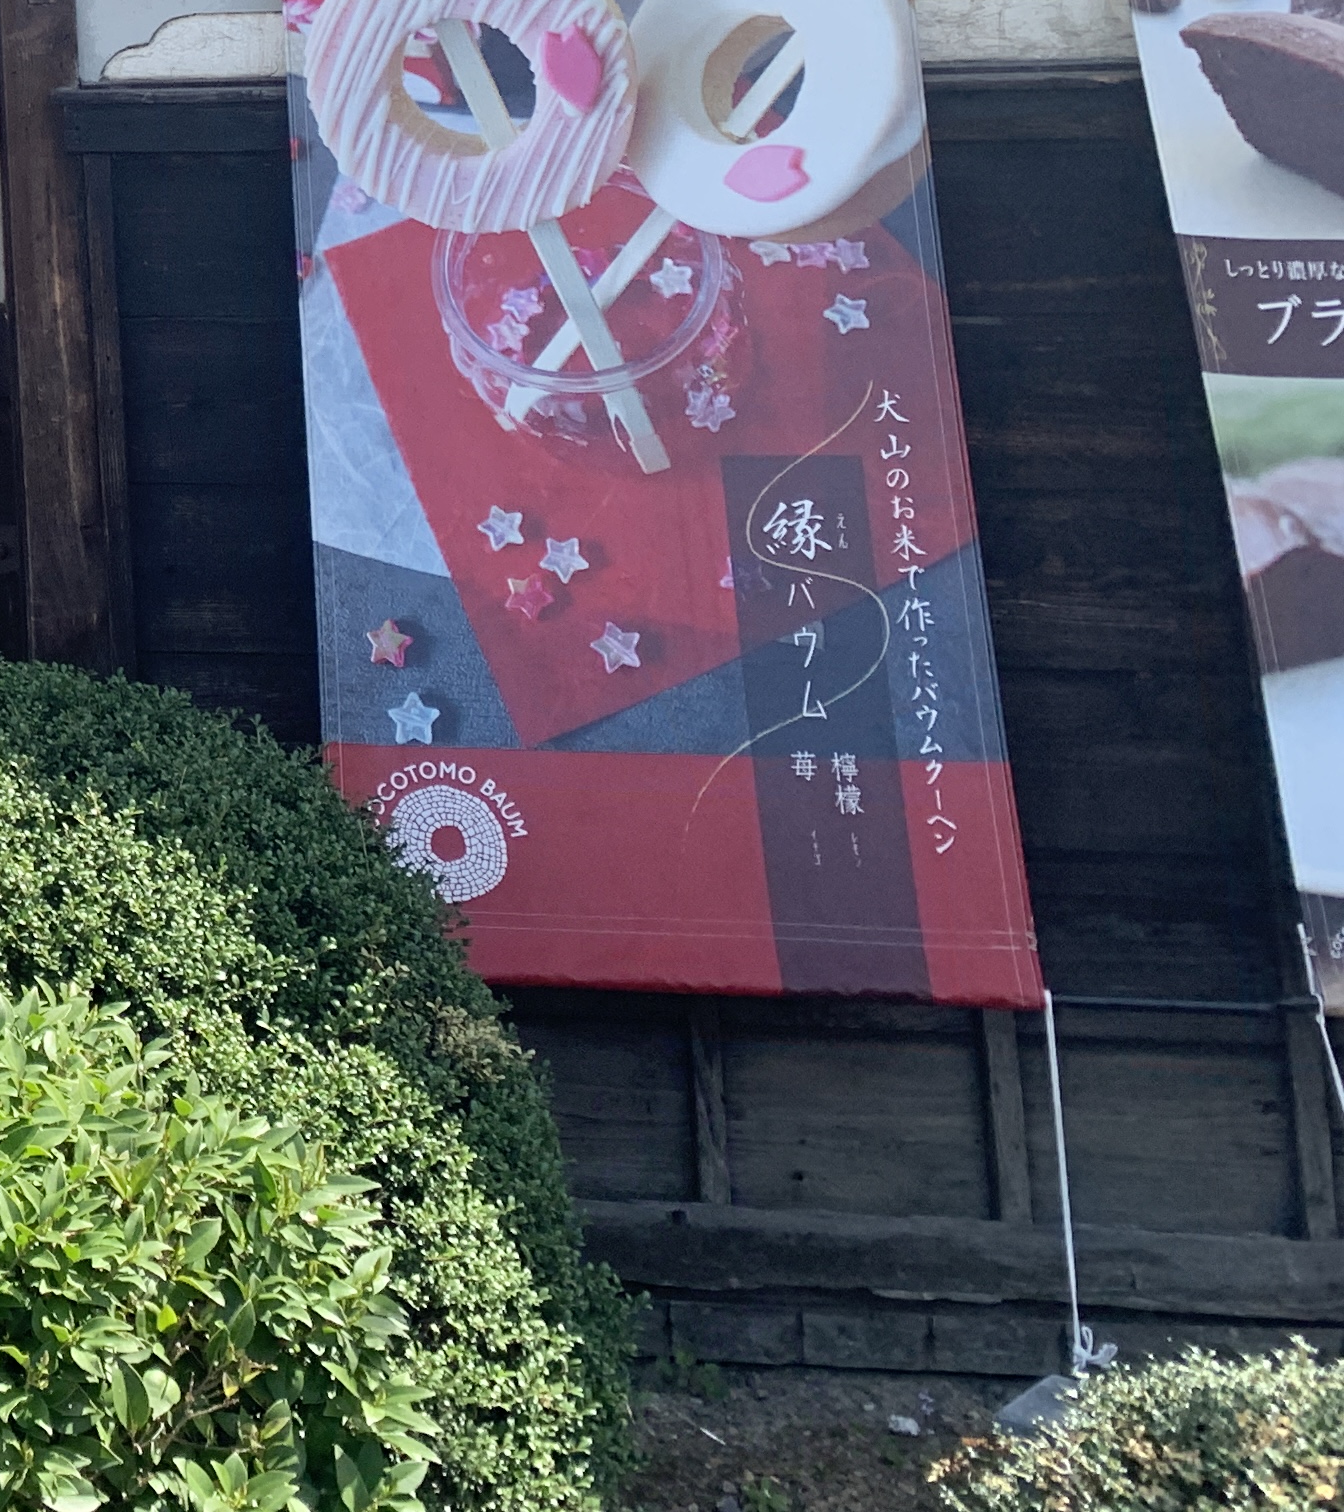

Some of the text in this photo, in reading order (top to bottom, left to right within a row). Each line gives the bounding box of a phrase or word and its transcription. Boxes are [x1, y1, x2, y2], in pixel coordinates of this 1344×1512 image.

[873, 389, 957, 854] 犬山のお米で作ったバウムクーヘン
[367, 761, 528, 838] OCOTOMO BAUM
[790, 750, 818, 781] 苺
